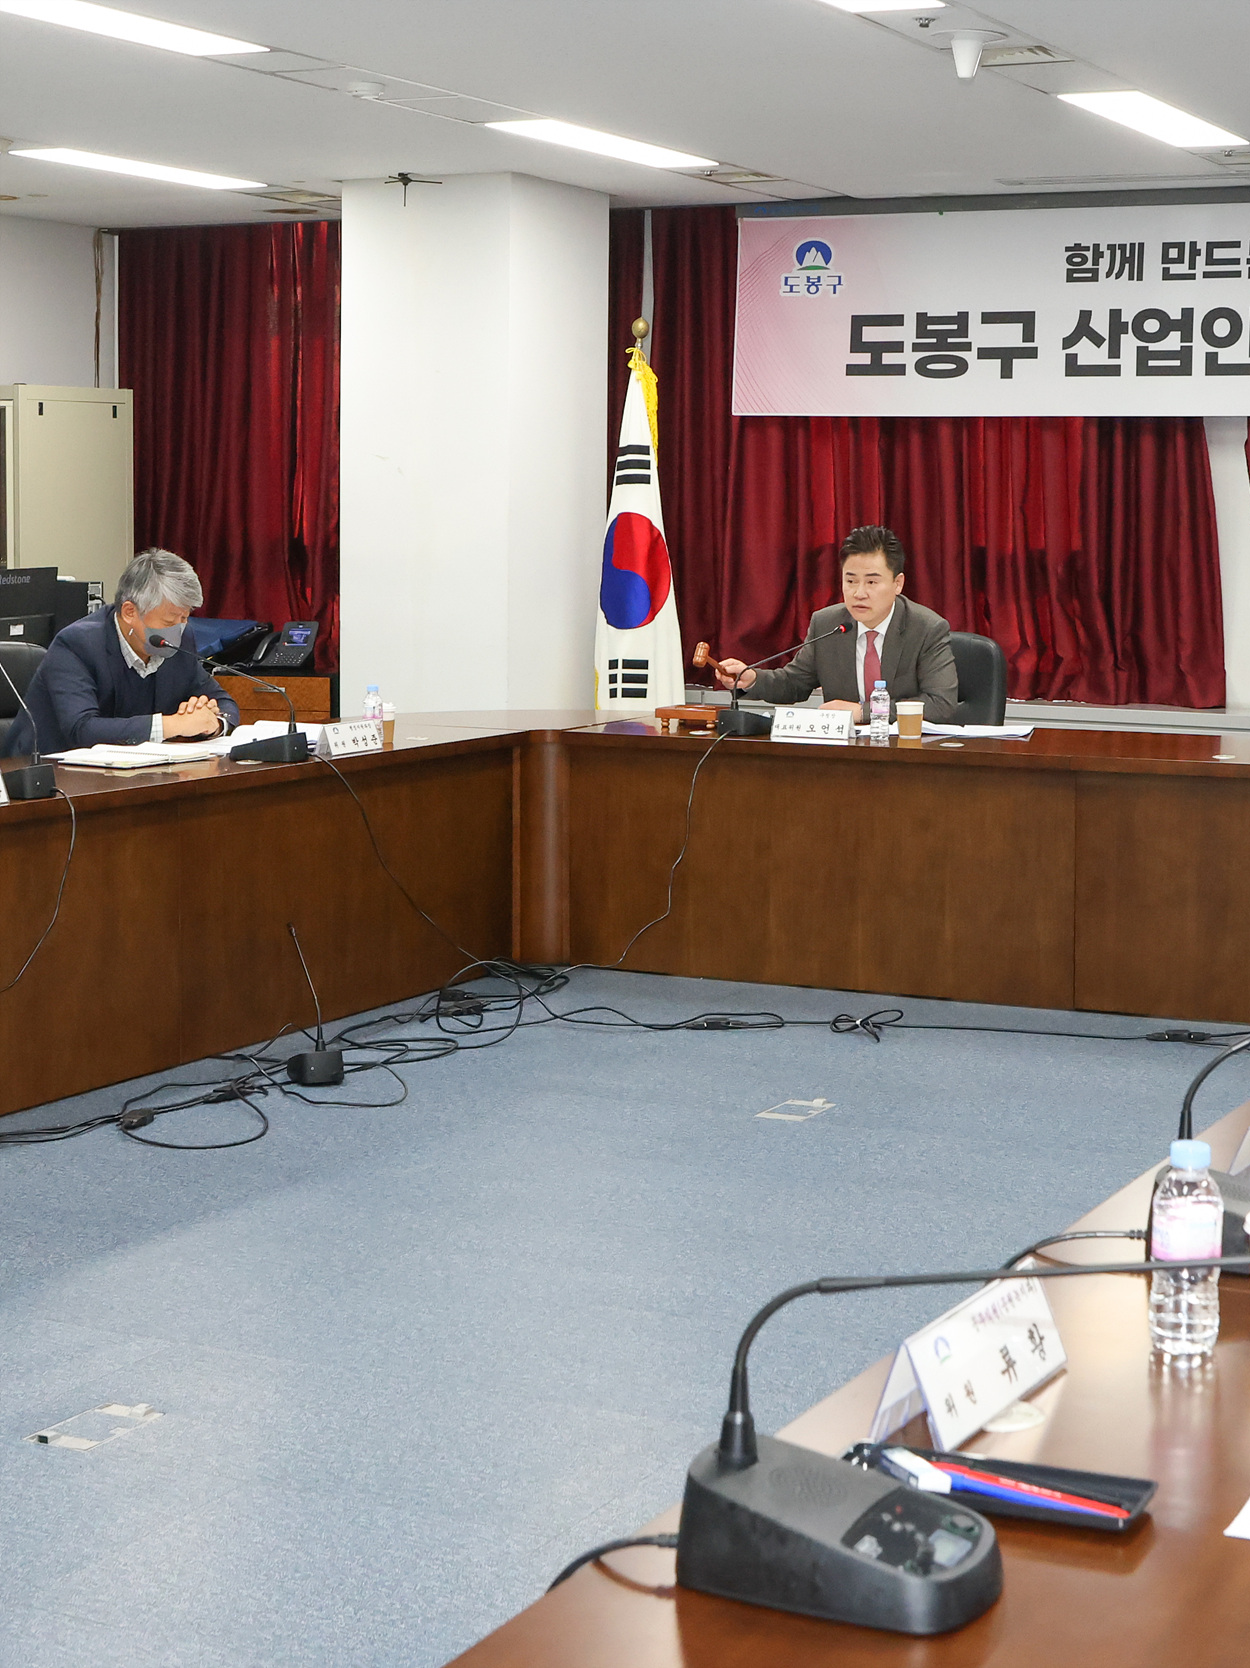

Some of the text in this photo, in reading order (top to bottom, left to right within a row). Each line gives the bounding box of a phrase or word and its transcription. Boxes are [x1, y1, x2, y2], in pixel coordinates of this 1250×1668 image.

[1064, 242, 1145, 283] 함께
[782, 275, 844, 295] 도봉구
[845, 310, 1039, 380] 도봉구
[806, 723, 844, 735] 오언석
